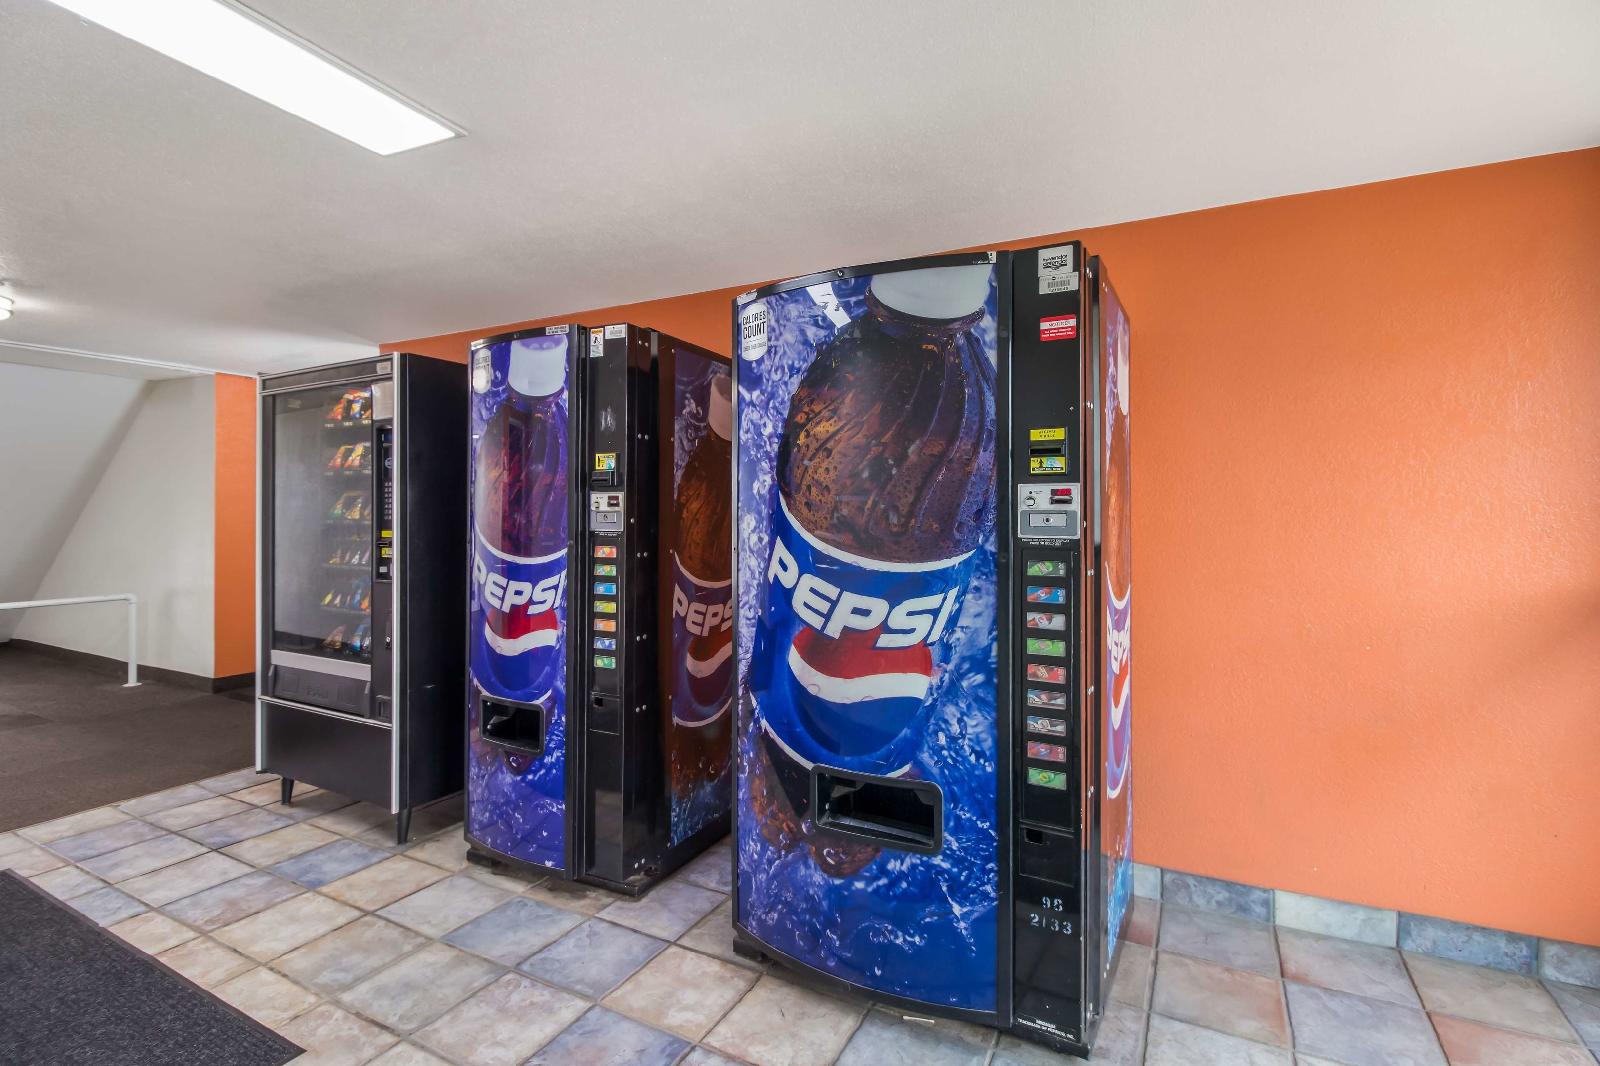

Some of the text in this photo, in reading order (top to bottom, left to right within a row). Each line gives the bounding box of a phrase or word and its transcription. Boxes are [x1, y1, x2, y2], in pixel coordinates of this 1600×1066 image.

[743, 321, 766, 339] COUNT
[472, 553, 567, 615] PEPSI
[673, 583, 733, 637] PEPS
[768, 536, 959, 648] PEPSI
[1030, 913, 1072, 935] 2133
